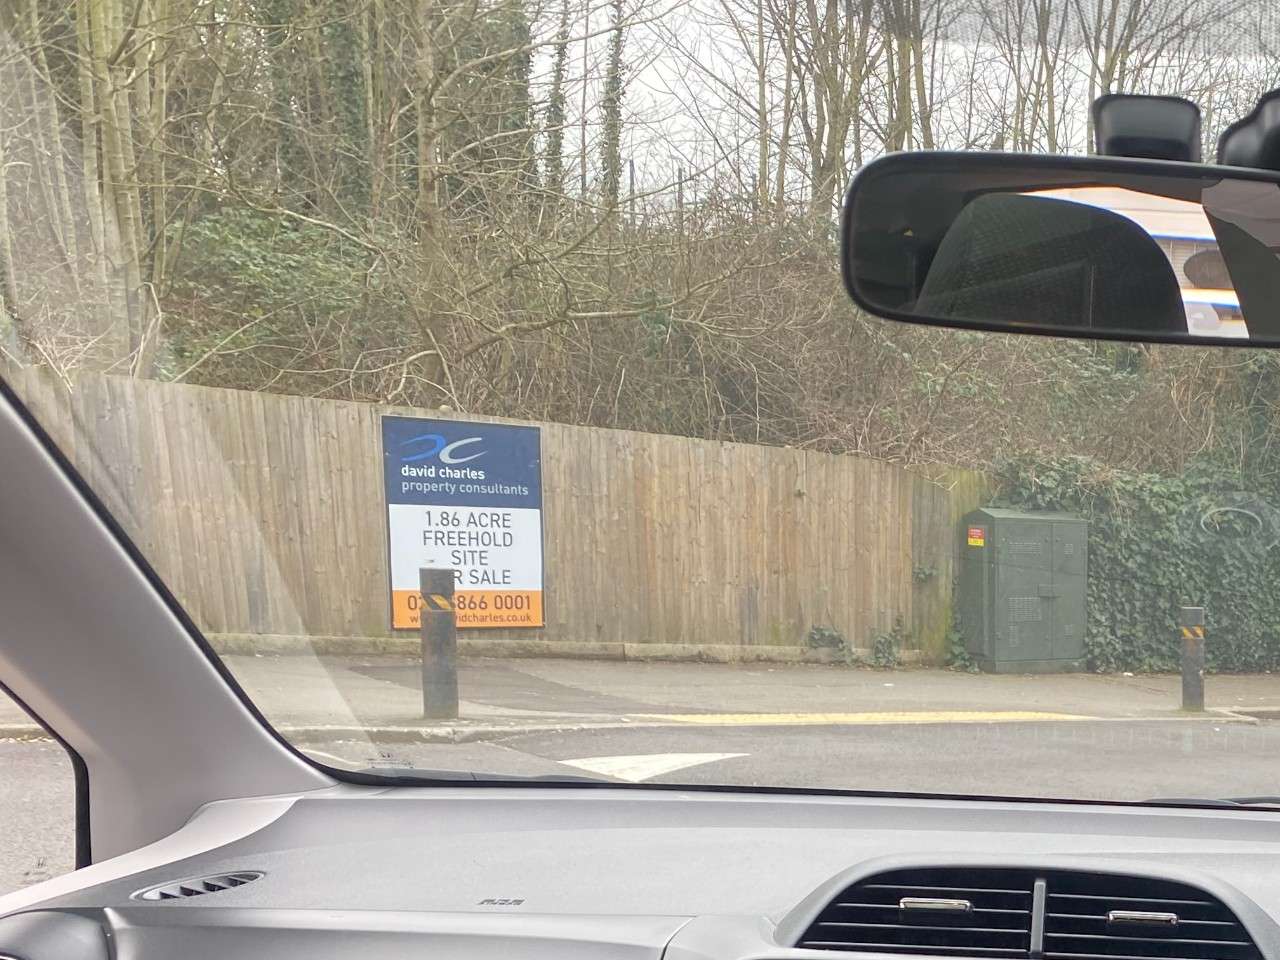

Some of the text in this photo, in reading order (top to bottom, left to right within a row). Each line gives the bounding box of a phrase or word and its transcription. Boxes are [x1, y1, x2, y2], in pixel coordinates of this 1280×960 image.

[401, 465, 485, 479] david charles
[402, 481, 529, 495] property consultants
[426, 511, 511, 528] 1.86 ACRE
[423, 530, 513, 547] FREEHOLD
[451, 550, 488, 566] SITE
[469, 569, 511, 585] SALE
[456, 595, 531, 610] 866 0001
